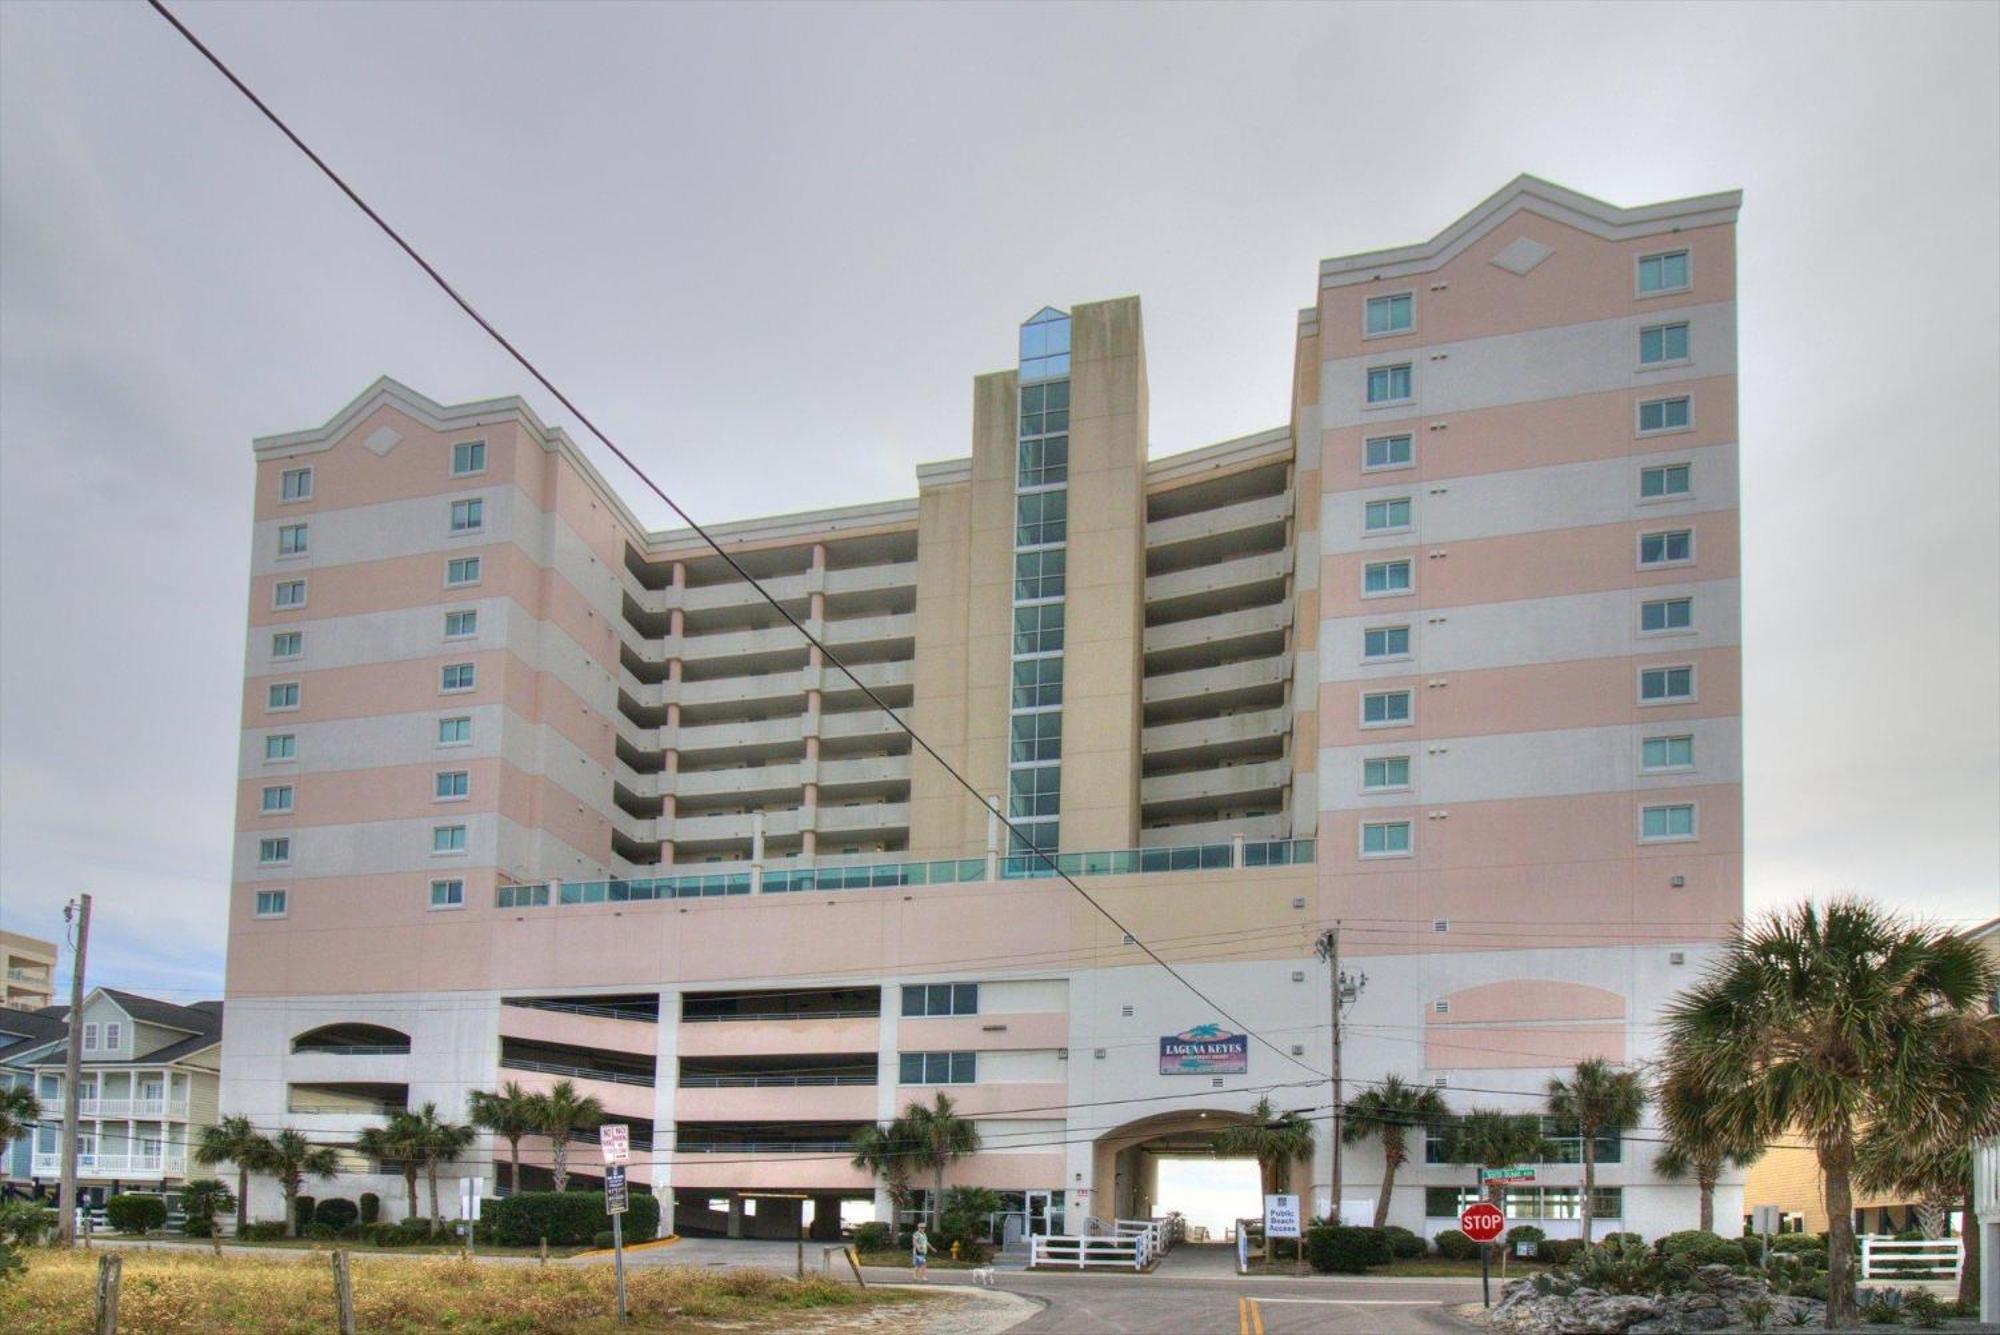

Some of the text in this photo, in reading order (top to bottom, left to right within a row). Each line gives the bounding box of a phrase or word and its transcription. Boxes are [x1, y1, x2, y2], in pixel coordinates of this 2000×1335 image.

[1166, 1043, 1242, 1055] LAGUNA KEYES
[1270, 1209, 1295, 1217] Public
[1463, 1214, 1501, 1230] STOP
